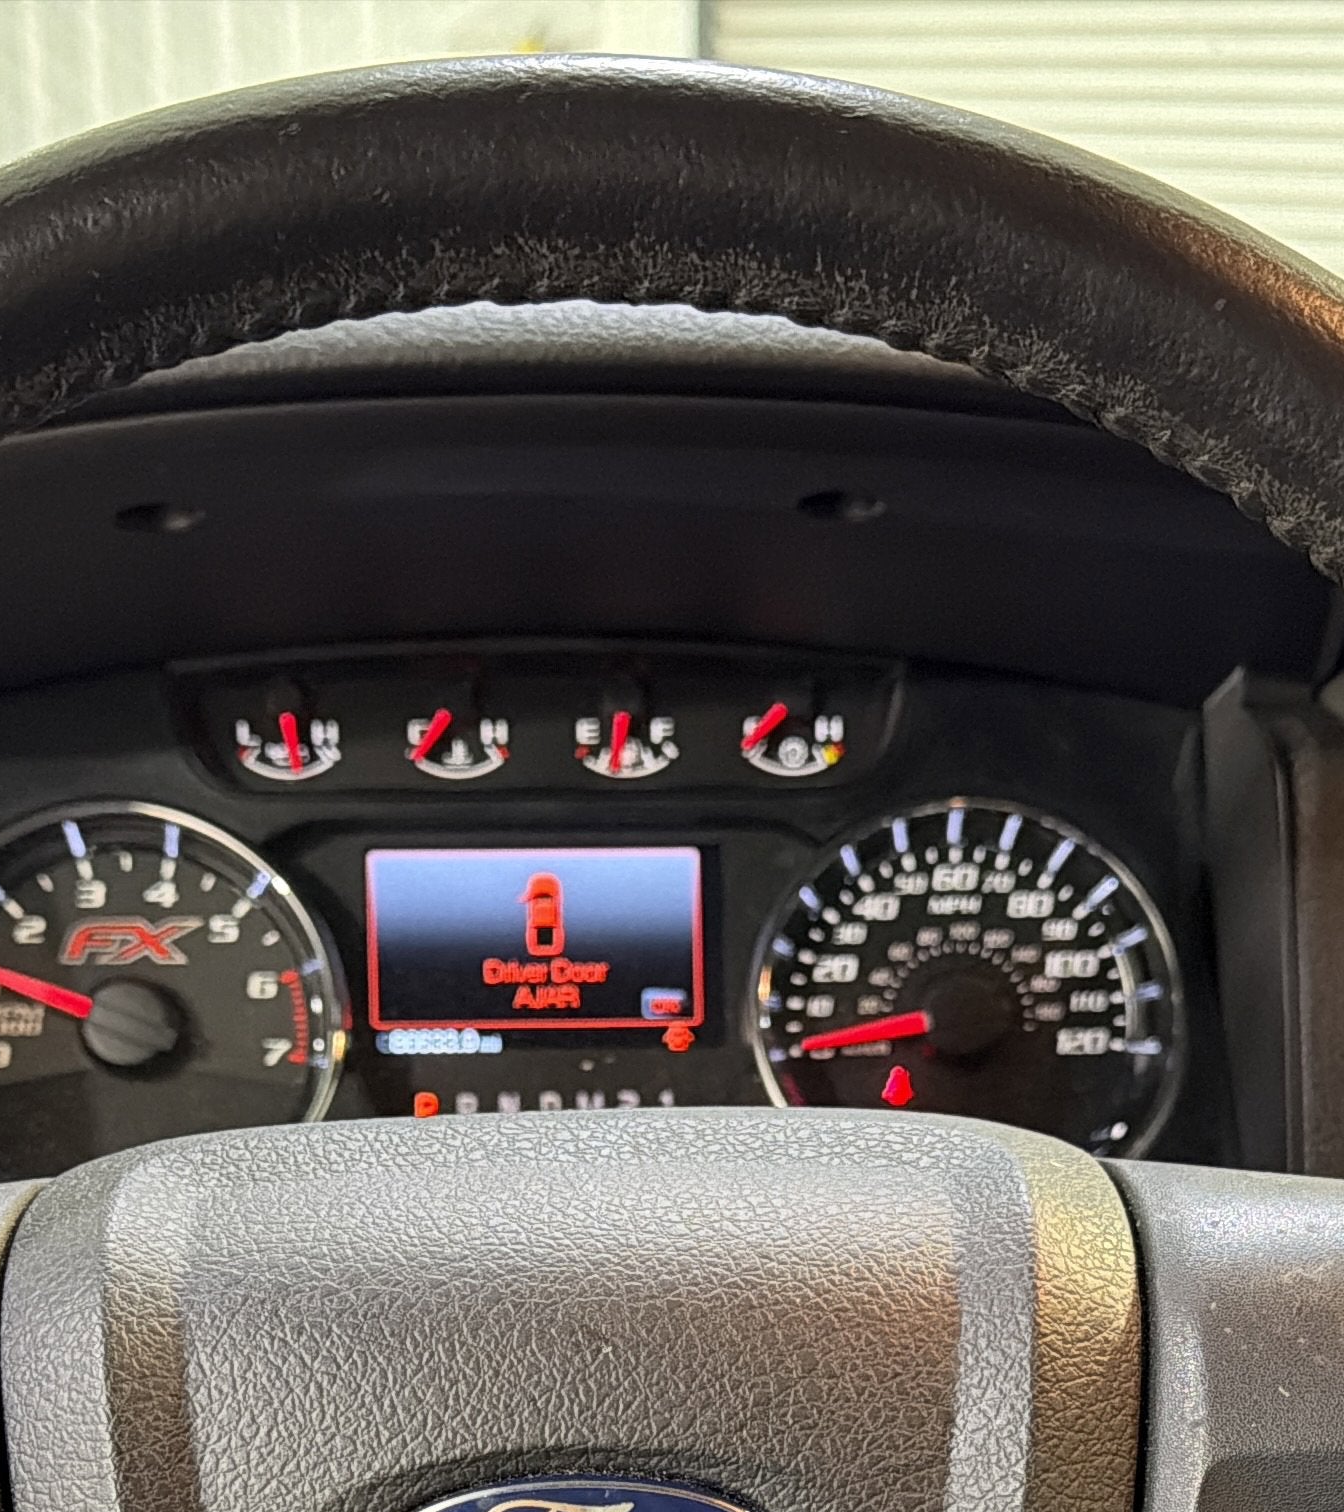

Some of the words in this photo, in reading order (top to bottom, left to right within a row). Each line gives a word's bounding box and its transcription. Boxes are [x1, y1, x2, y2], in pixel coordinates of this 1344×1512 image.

[575, 717, 601, 745] E
[650, 716, 675, 744] F
[932, 864, 980, 891] 60
[76, 879, 107, 909] 3
[142, 879, 180, 909] 4
[12, 915, 47, 945] 2
[58, 915, 205, 966] FX
[207, 913, 240, 944] 5
[247, 970, 278, 999] 6
[482, 958, 549, 984] Driver
[551, 958, 610, 984] Door
[263, 1040, 292, 1066] 7
